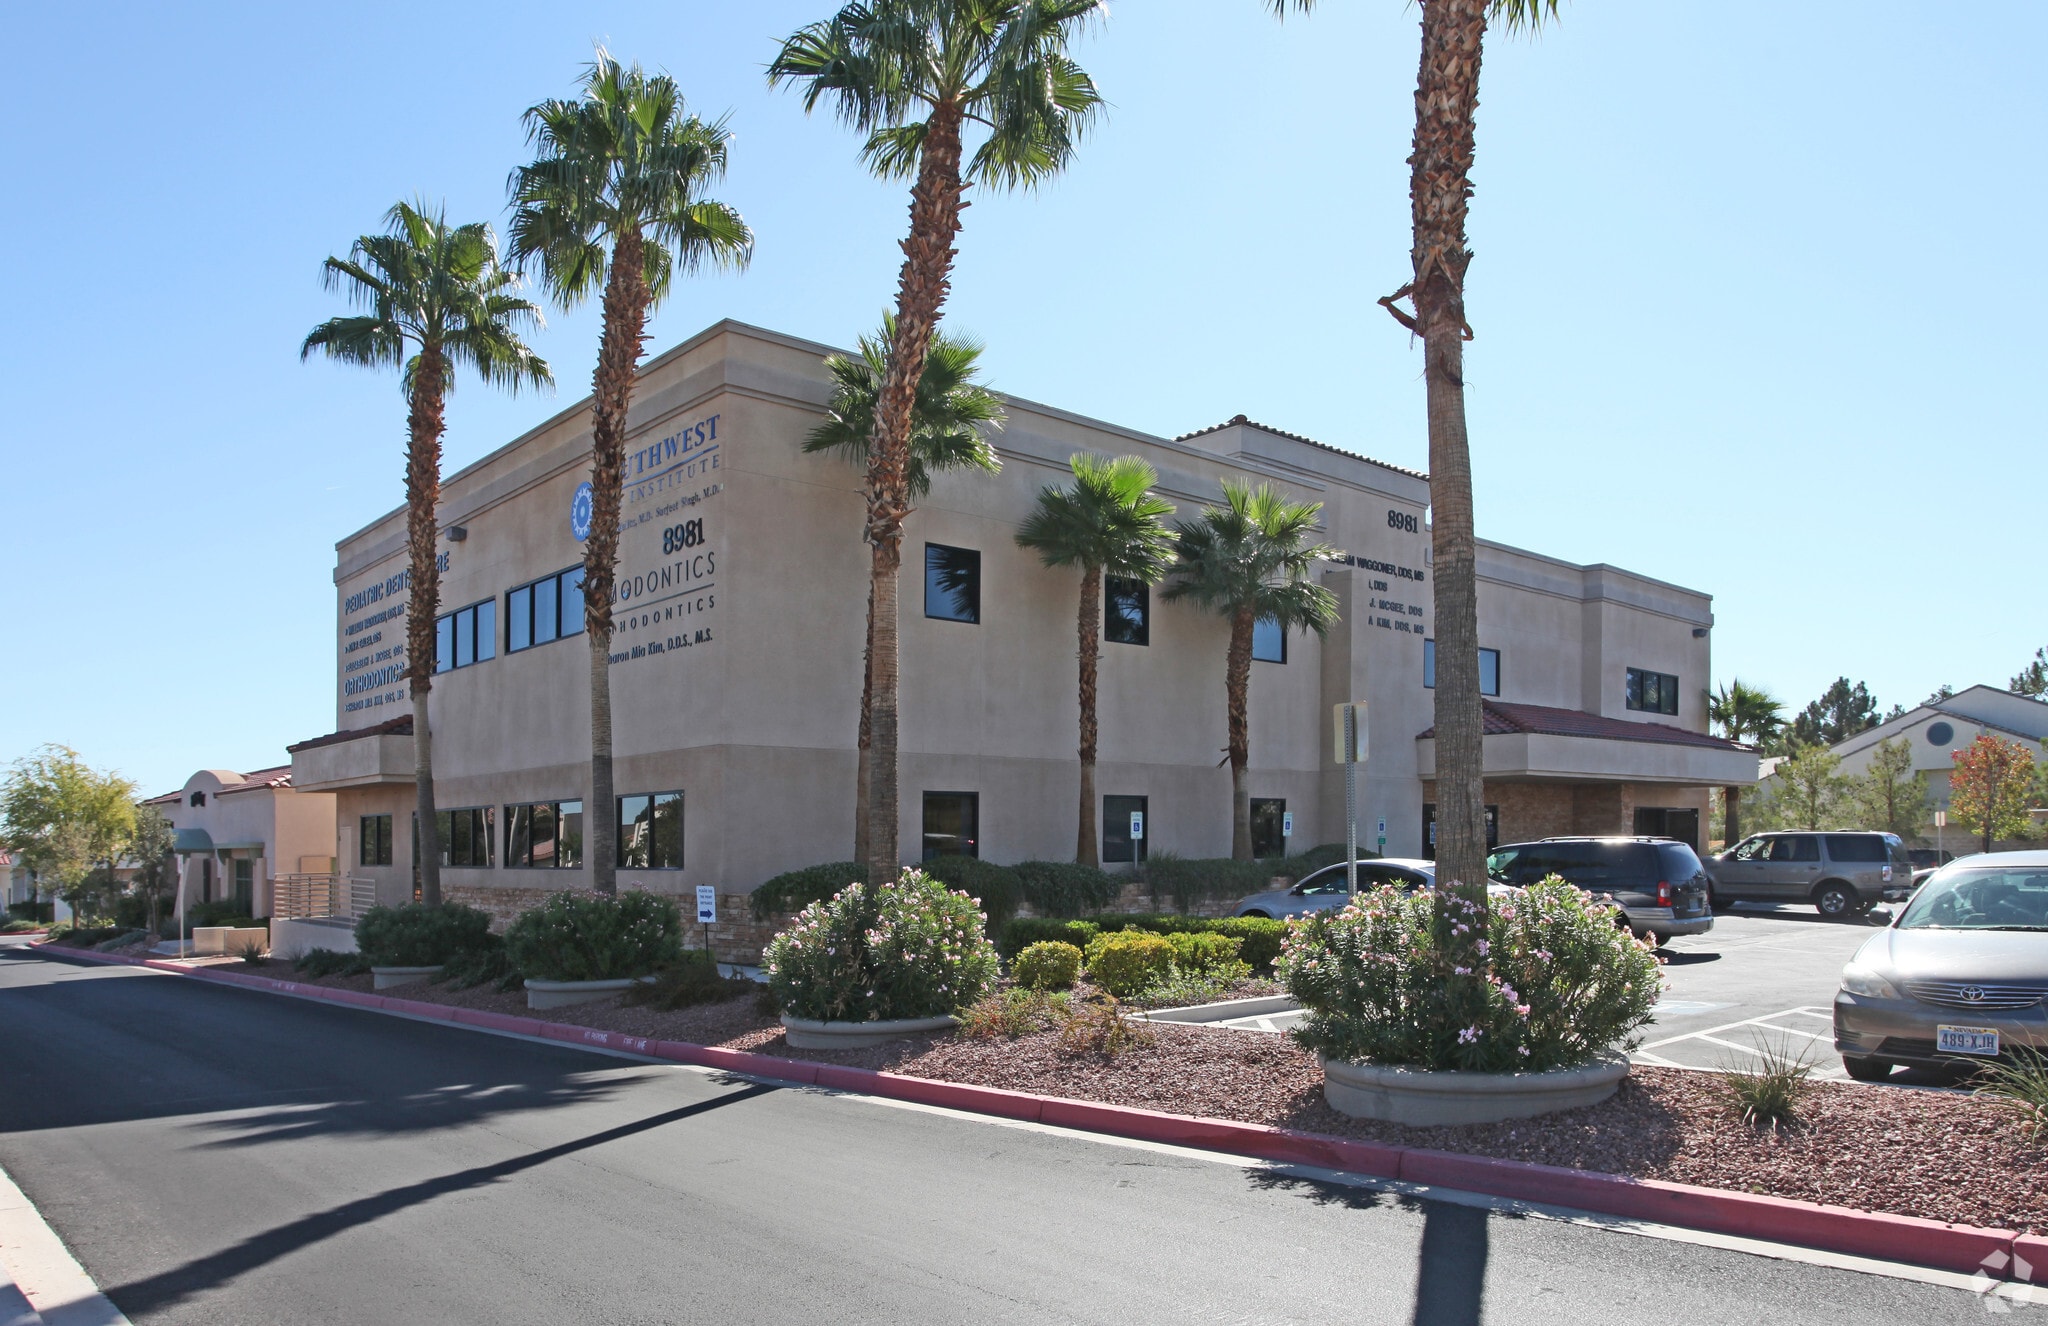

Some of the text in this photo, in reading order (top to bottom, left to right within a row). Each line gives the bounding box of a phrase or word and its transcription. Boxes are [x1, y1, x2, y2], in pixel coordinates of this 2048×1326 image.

[621, 413, 721, 480] UTHWEST
[630, 454, 720, 503] INSTITUTE
[663, 517, 705, 555] 8981
[1387, 509, 1418, 534] 8981
[345, 550, 450, 616] PEDIATRIC DENT RE
[1356, 556, 1397, 578] WAGGONER,
[1398, 566, 1413, 582] DDS,
[1414, 570, 1424, 582] MS
[1374, 580, 1388, 592] DDS
[611, 594, 715, 634] HODONTICS
[1376, 617, 1392, 630] KIM,
[1395, 621, 1411, 634] DDS,
[1414, 624, 1424, 635] MS
[1379, 600, 1406, 616] MCGEE,
[1408, 605, 1423, 618] DDS
[608, 627, 713, 666] haron Mia Kim, D.D.S., M.S.
[345, 661, 405, 697] ORTHODONTICS
[1953, 1026, 1982, 1034] NEVADA
